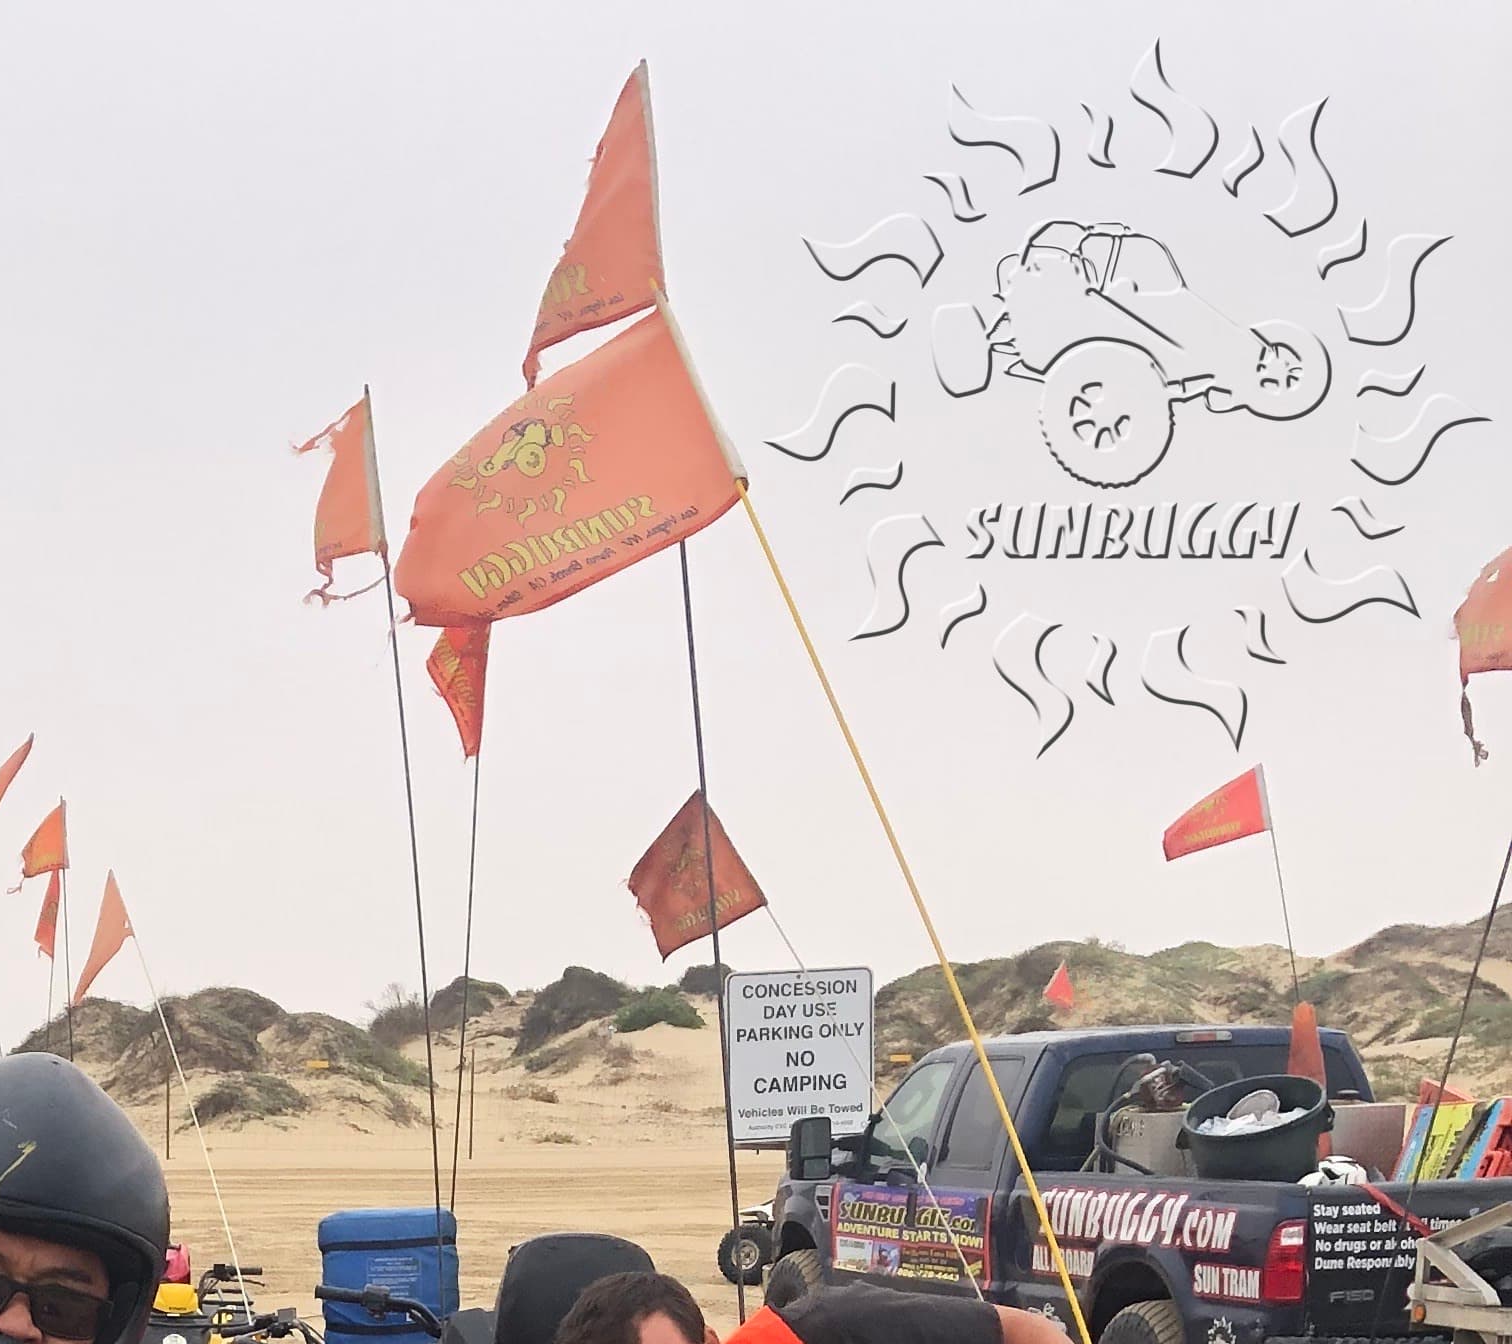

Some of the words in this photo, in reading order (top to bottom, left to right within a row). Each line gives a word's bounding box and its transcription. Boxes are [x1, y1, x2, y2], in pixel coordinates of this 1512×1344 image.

[742, 979, 857, 999] CONCESSION
[763, 1004, 797, 1019] DAY
[802, 1002, 837, 1018] USE
[736, 1024, 813, 1042] PARKING
[819, 1022, 865, 1038] ONLY
[786, 1050, 815, 1067] NO
[753, 1073, 847, 1094] CAMPING
[738, 1107, 784, 1118] Vehicles
[787, 1105, 807, 1116] Will
[810, 1104, 825, 1115] Be
[828, 1102, 863, 1114] Towed
[839, 1201, 977, 1233] SUNBUGIE.co
[1313, 1203, 1339, 1218] Stay
[1342, 1202, 1381, 1216] seated
[838, 1222, 899, 1239] ADVENTURE
[901, 1229, 947, 1244] STARTS
[1314, 1221, 1345, 1234] Wear
[1346, 1220, 1372, 1234] seat
[1373, 1218, 1397, 1232] belt
[1315, 1240, 1332, 1252] No
[1334, 1238, 1367, 1253] drugs
[1369, 1240, 1383, 1250] or
[1032, 1245, 1049, 1271] ALL
[1314, 1257, 1344, 1270] Dune
[1194, 1264, 1221, 1294] SUN
[1222, 1267, 1261, 1299] TRAM
[1330, 1289, 1375, 1304] F150
